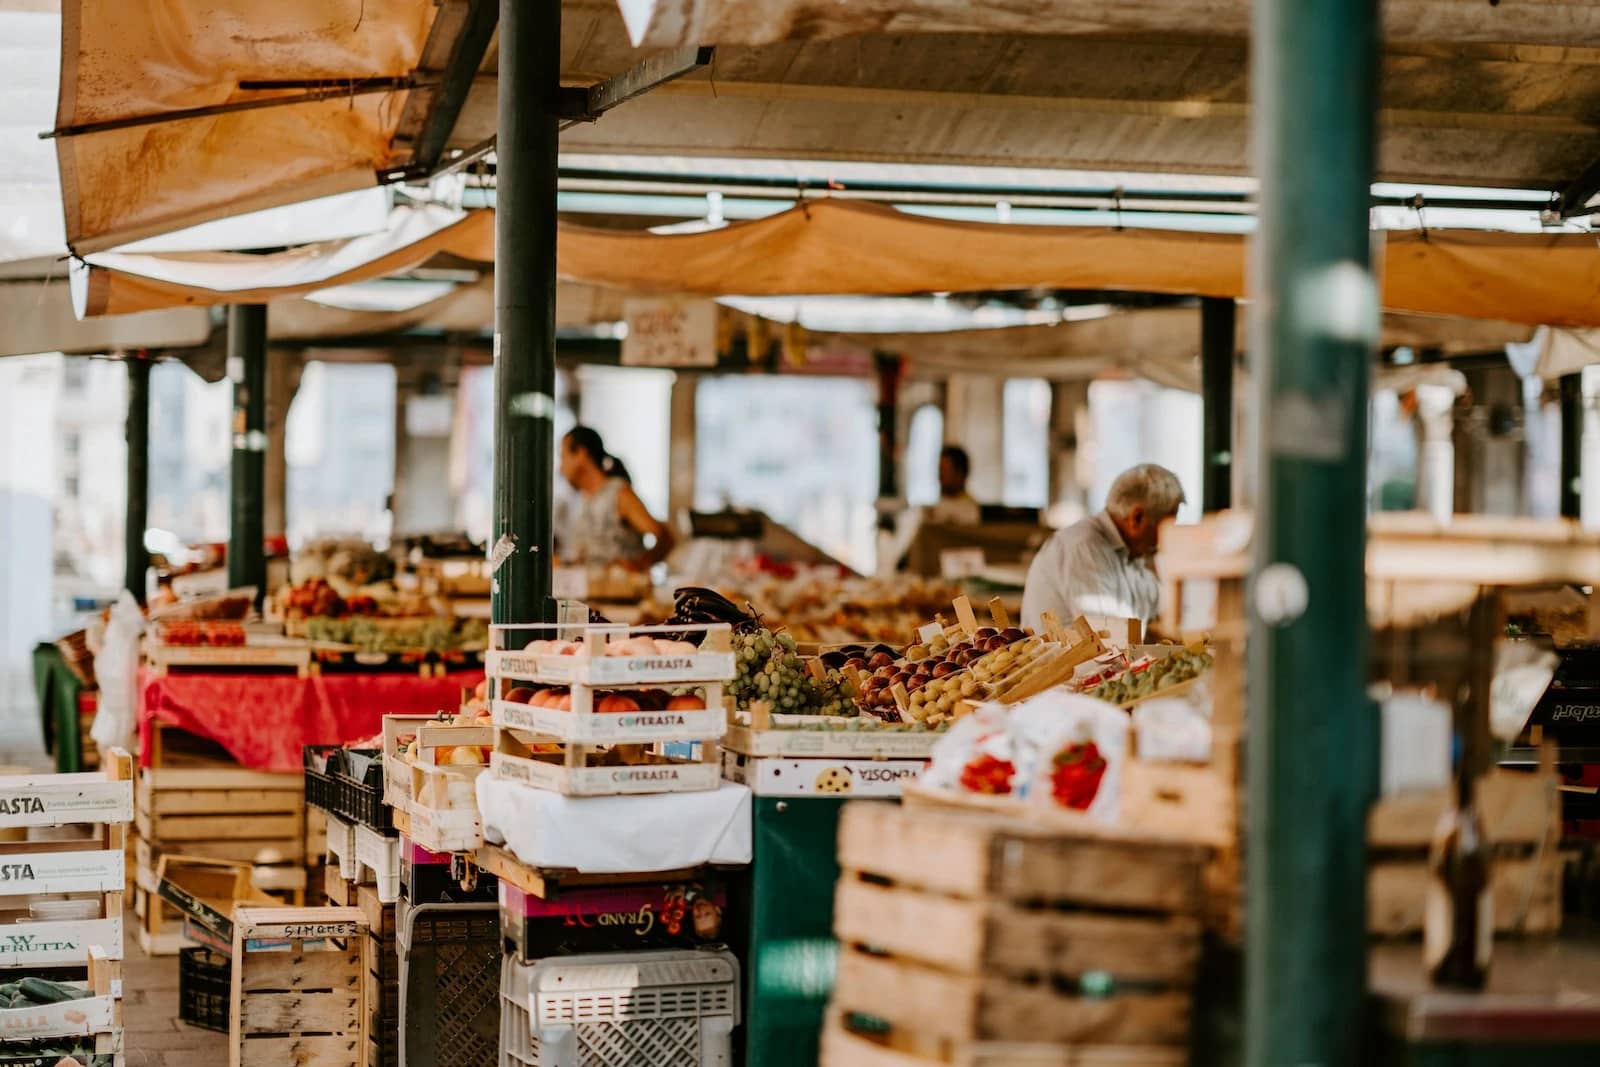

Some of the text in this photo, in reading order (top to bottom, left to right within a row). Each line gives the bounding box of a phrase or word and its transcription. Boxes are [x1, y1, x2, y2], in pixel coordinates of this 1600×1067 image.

[627, 659, 693, 671] COFERASTA
[618, 715, 684, 727] COFERASTA
[612, 769, 679, 781] COFERASTA
[0, 797, 45, 814] ASTA
